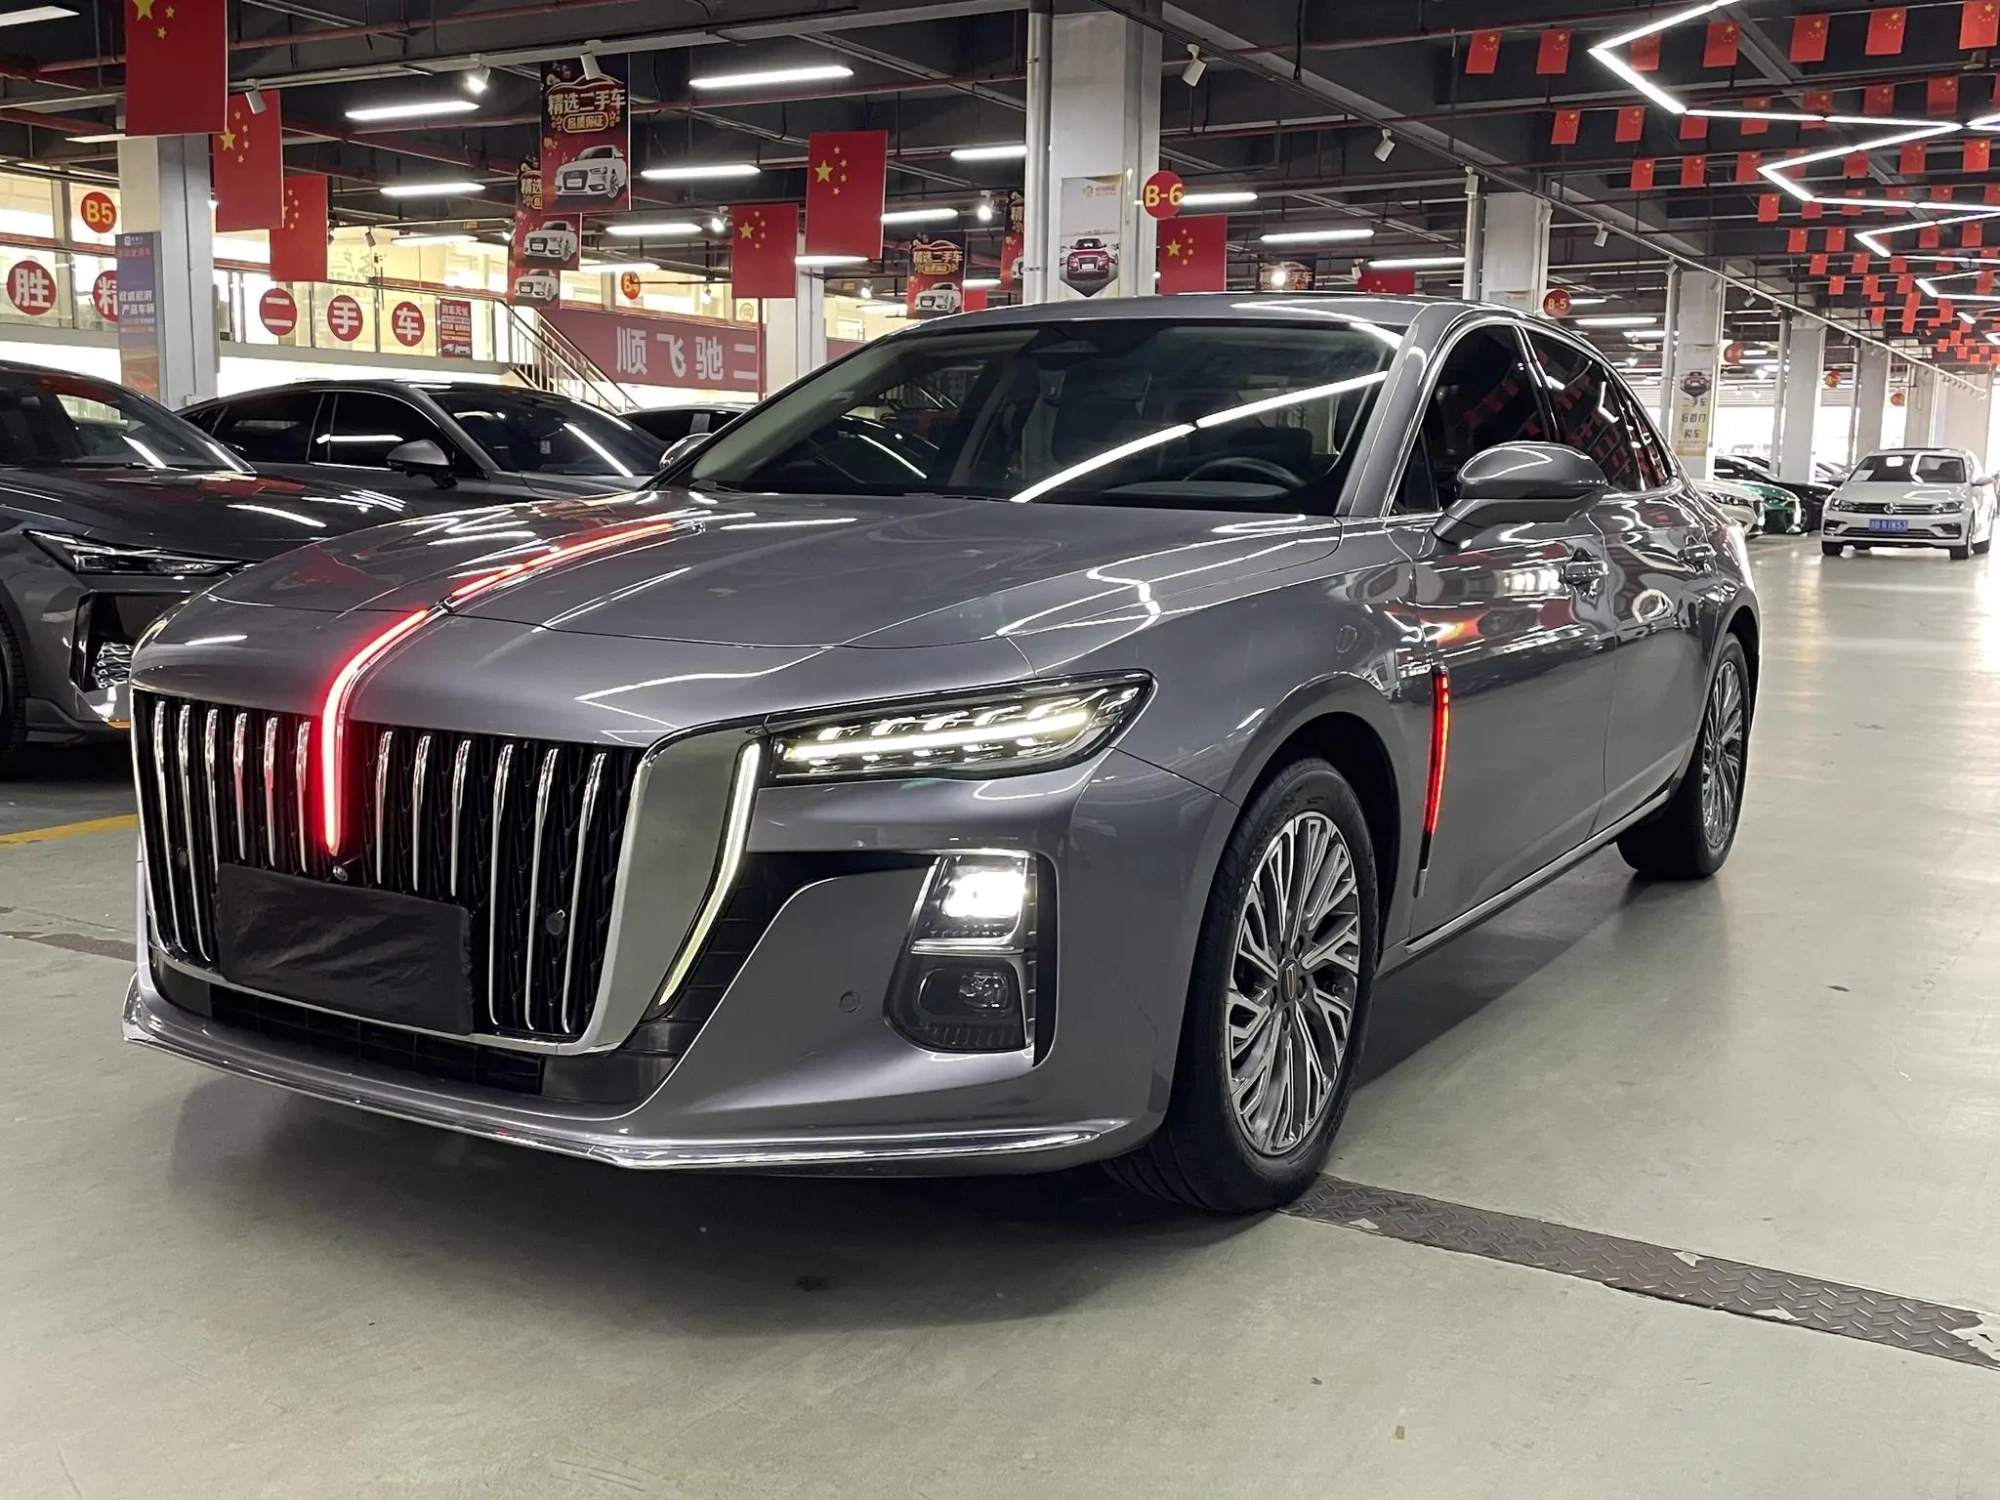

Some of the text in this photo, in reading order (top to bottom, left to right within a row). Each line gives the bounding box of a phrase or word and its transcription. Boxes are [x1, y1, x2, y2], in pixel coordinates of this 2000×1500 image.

[548, 88, 626, 115] 精选二手车
[567, 115, 604, 129] 品质保证
[1145, 183, 1183, 207] B-6
[86, 200, 113, 224] B5
[616, 326, 759, 381] 顺飞驰二
